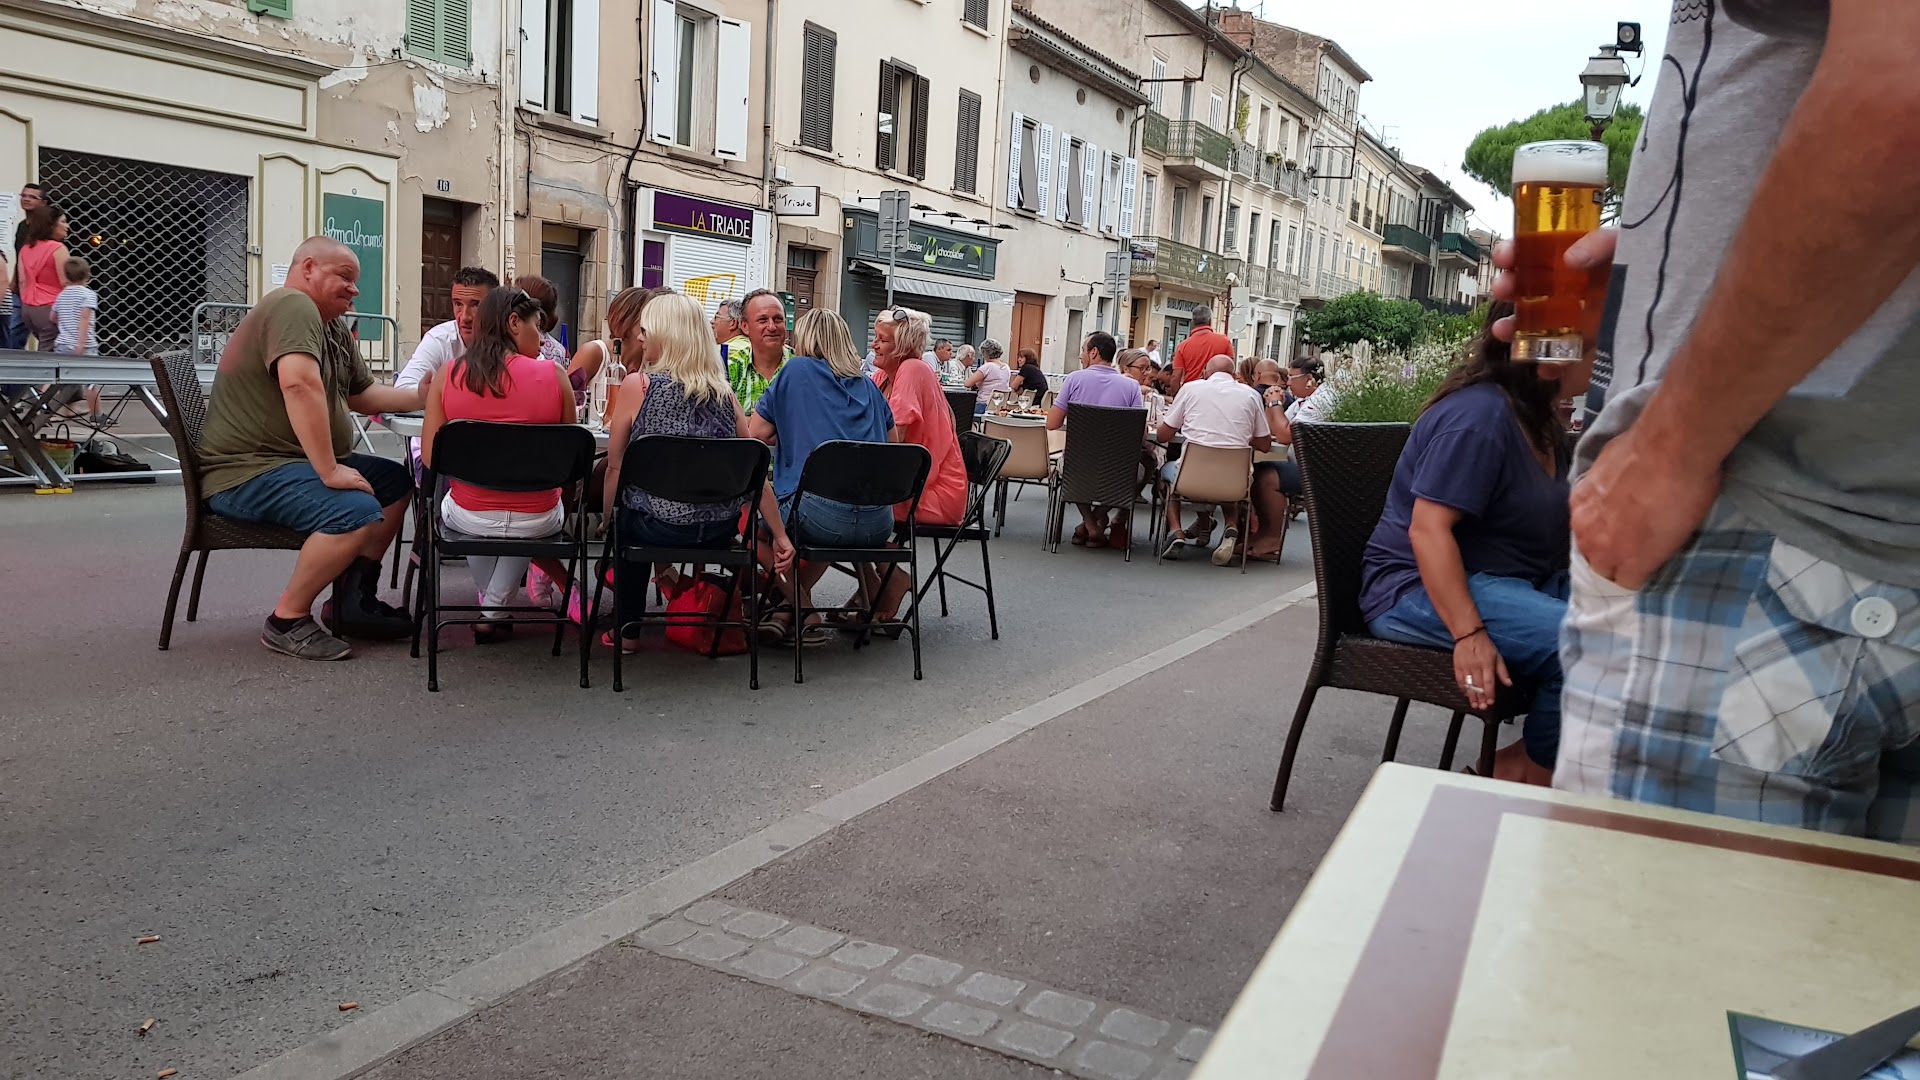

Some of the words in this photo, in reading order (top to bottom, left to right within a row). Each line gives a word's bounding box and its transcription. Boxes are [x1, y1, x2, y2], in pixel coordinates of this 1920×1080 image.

[438, 180, 449, 191] 16
[782, 193, 812, 208] Triade
[691, 210, 706, 230] LA
[709, 213, 751, 238] TRIADE
[938, 246, 964, 260] chocolatier
